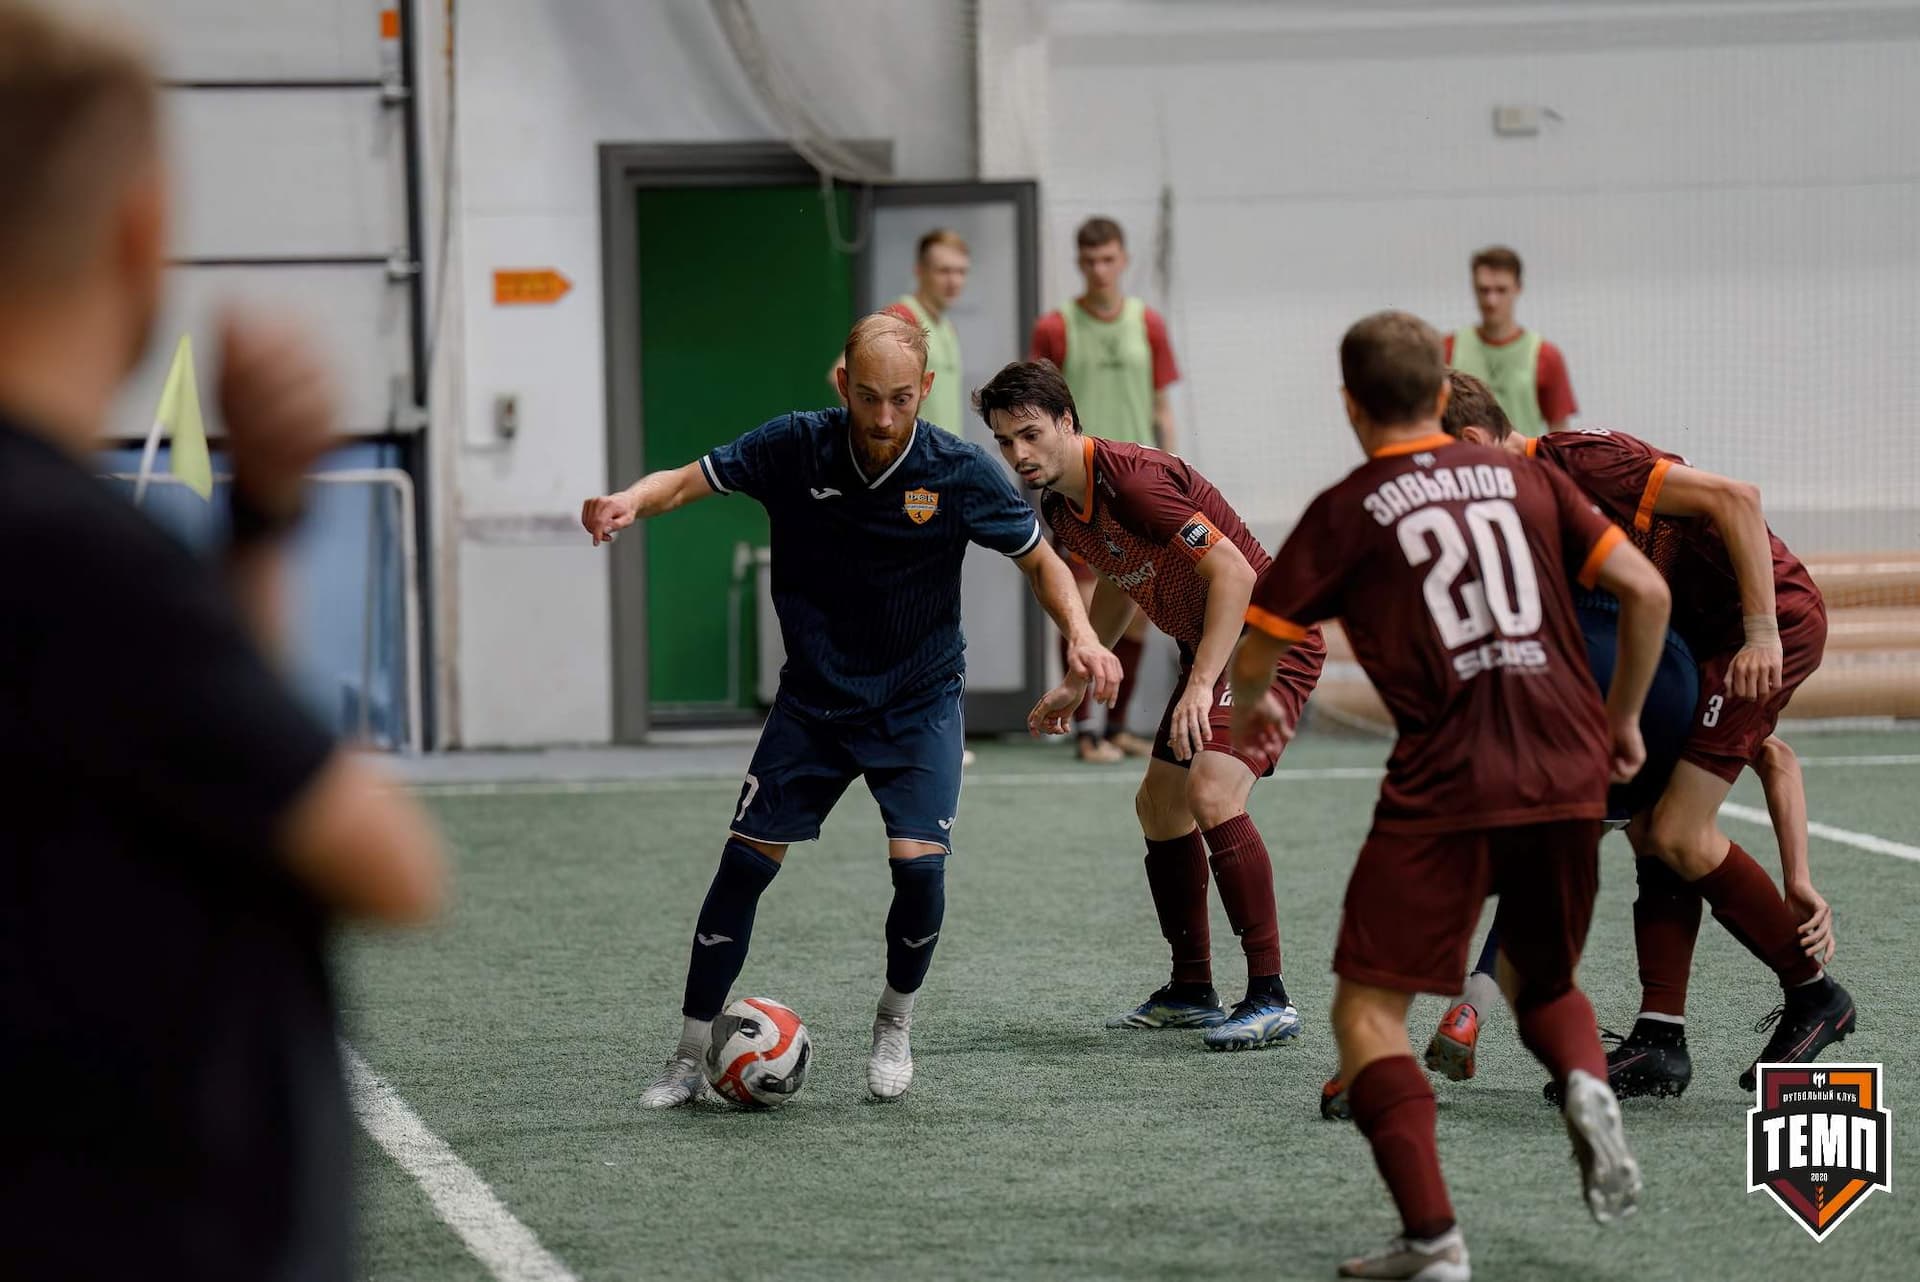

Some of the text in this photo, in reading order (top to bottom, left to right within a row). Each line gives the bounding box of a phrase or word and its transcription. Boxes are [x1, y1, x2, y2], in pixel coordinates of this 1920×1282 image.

[1363, 464, 1517, 527] ЗАВЬЯЛОВ
[1396, 499, 1542, 650] 20
[1702, 694, 1724, 728] 3
[735, 773, 760, 822] 7
